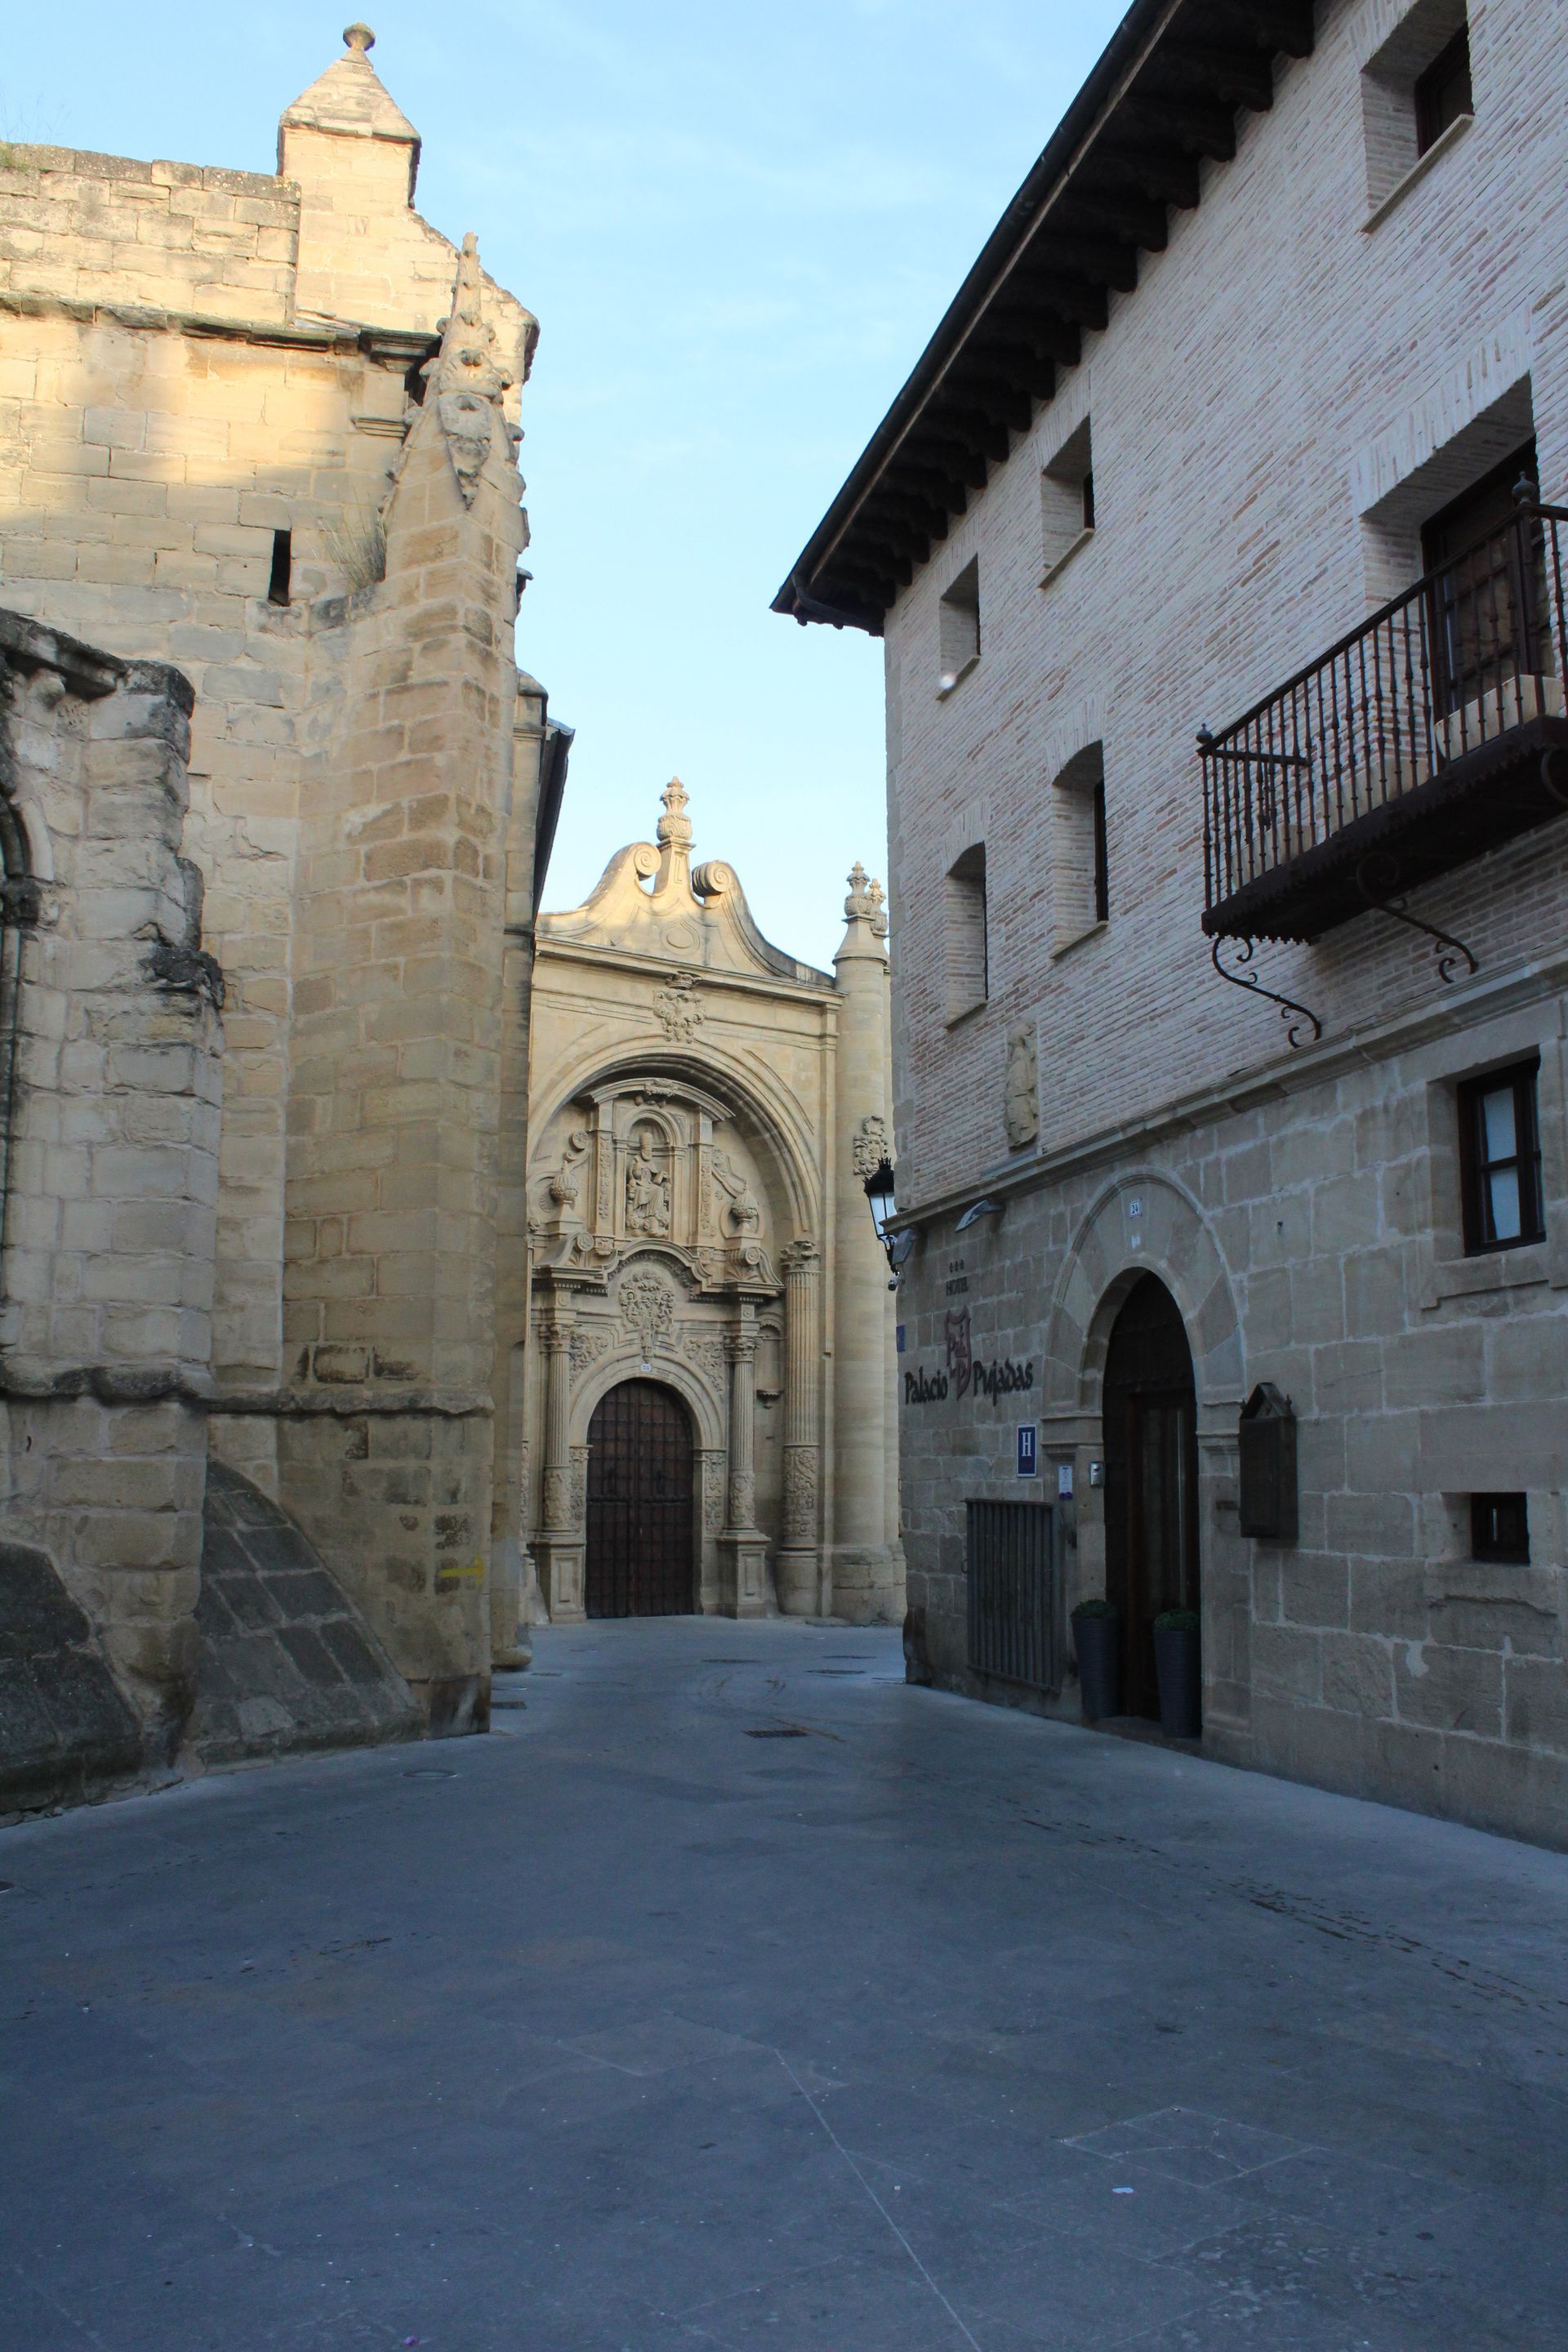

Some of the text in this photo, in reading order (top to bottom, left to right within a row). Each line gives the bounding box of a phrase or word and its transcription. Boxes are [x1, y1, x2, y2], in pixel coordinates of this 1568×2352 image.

[946, 1276, 969, 1297] HOTEL
[904, 1357, 1033, 1406] Palacio Pujadas
[1022, 1432, 1032, 1457] H
